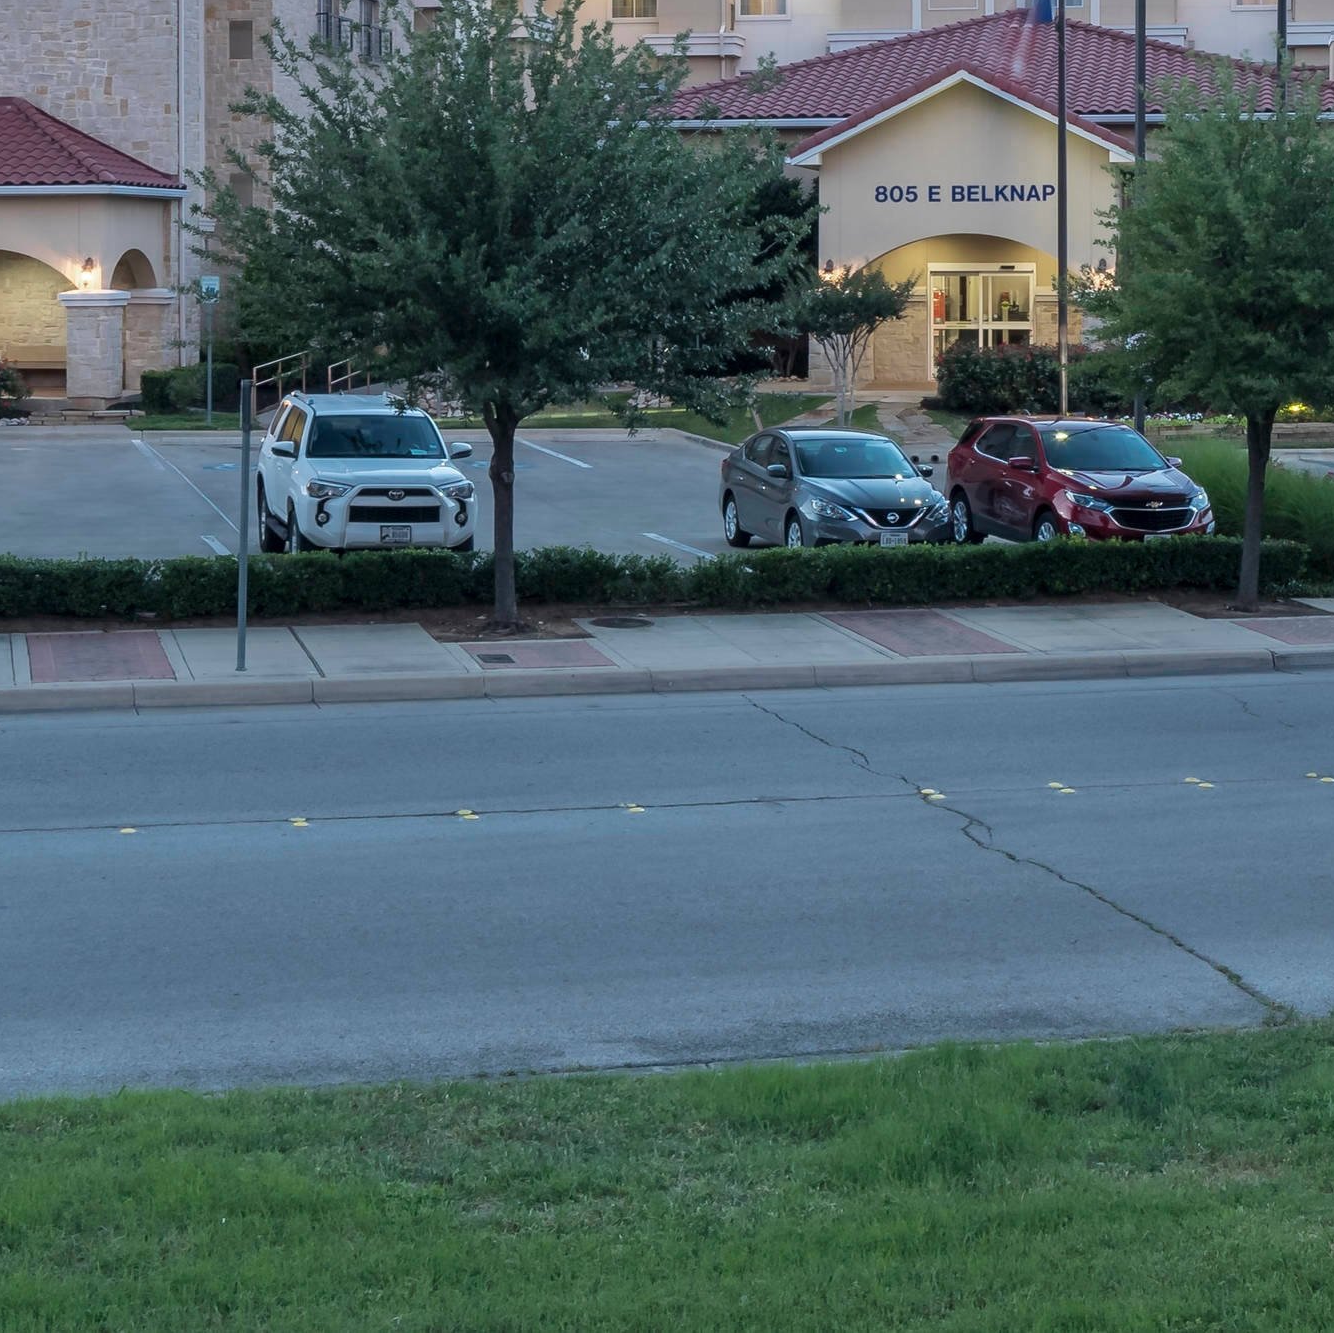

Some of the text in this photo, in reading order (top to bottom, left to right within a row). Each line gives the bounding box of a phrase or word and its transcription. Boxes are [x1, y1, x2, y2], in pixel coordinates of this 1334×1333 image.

[874, 184, 1056, 203] 805 E BELKNAP
